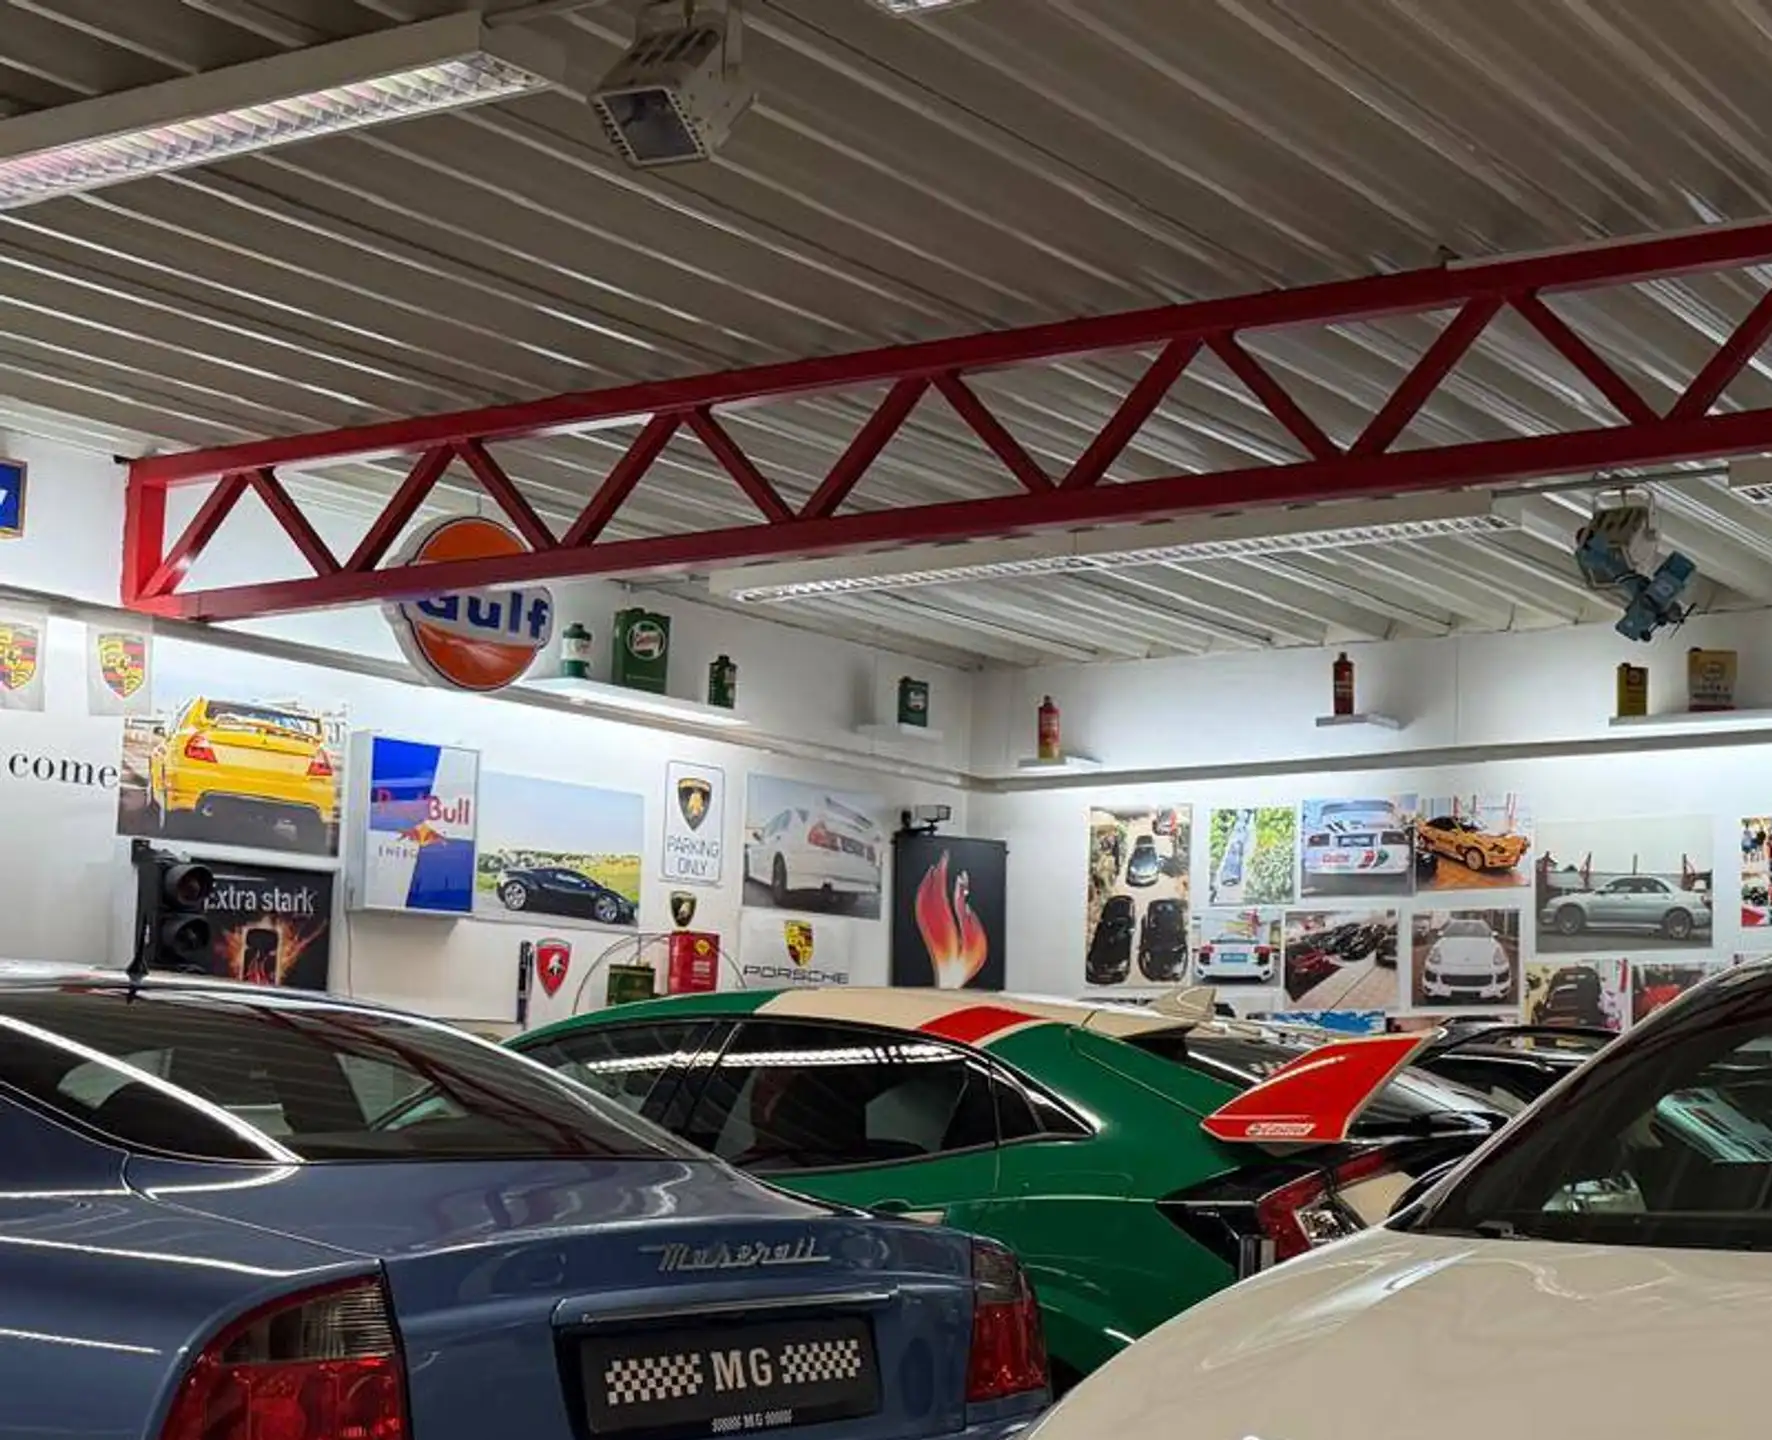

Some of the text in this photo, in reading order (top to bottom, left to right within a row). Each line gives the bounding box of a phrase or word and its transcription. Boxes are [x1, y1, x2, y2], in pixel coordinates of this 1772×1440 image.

[417, 590, 549, 639] Gulf
[8, 752, 118, 789] come
[425, 795, 471, 825] Bull
[667, 835, 719, 858] PARKING
[677, 857, 708, 876] ONLY
[260, 885, 320, 916] stark
[743, 964, 849, 985] PORSCHE
[638, 1236, 831, 1271] Maserati
[710, 1347, 773, 1392] MG
